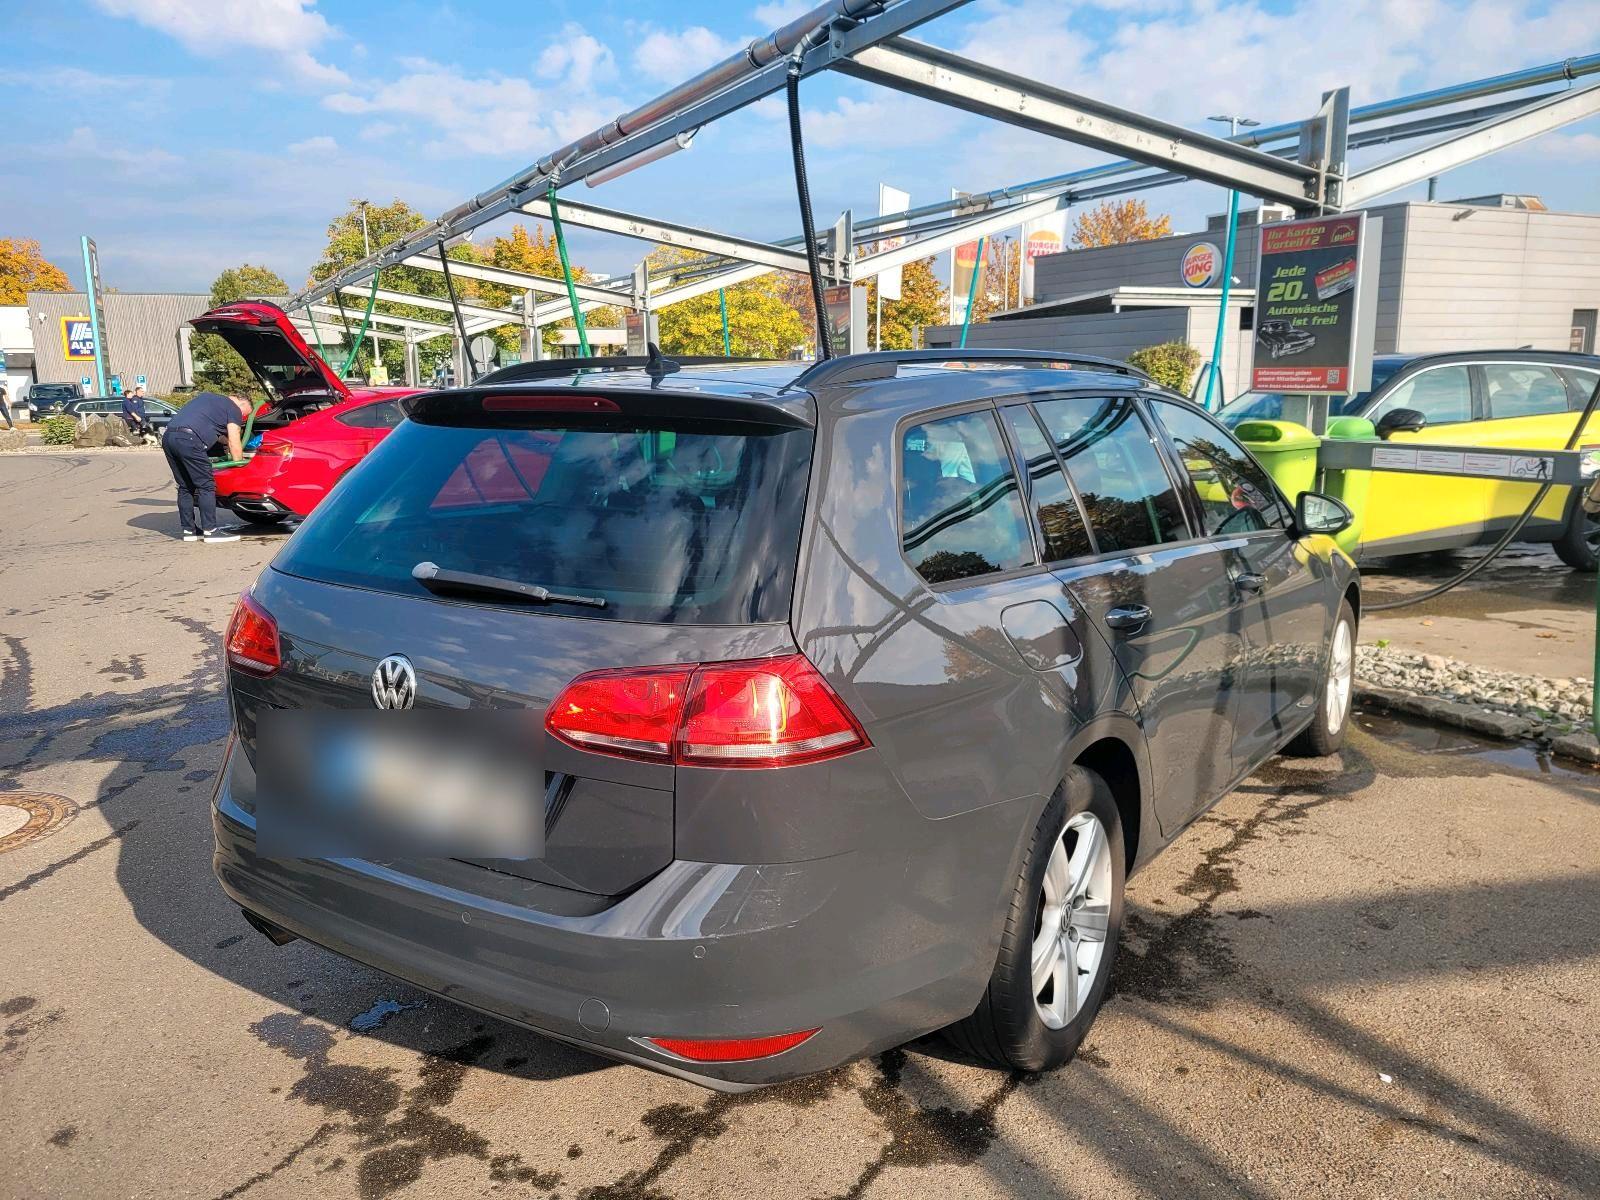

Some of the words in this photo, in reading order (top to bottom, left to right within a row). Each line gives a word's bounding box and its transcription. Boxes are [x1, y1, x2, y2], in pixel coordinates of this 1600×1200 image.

[1268, 229, 1284, 240] Ihr
[1287, 226, 1326, 237] Karten
[1027, 241, 1060, 249] BURGER
[1267, 238, 1303, 250] Vorteil
[1185, 253, 1212, 267] BURGER
[1184, 261, 1212, 277] KING
[1272, 266, 1306, 278] Jede
[1267, 281, 1308, 302] 20.
[1266, 304, 1338, 316] Autowäsche
[1292, 317, 1308, 327] ist
[1312, 315, 1338, 327] frei!
[71, 341, 94, 350] ALD
